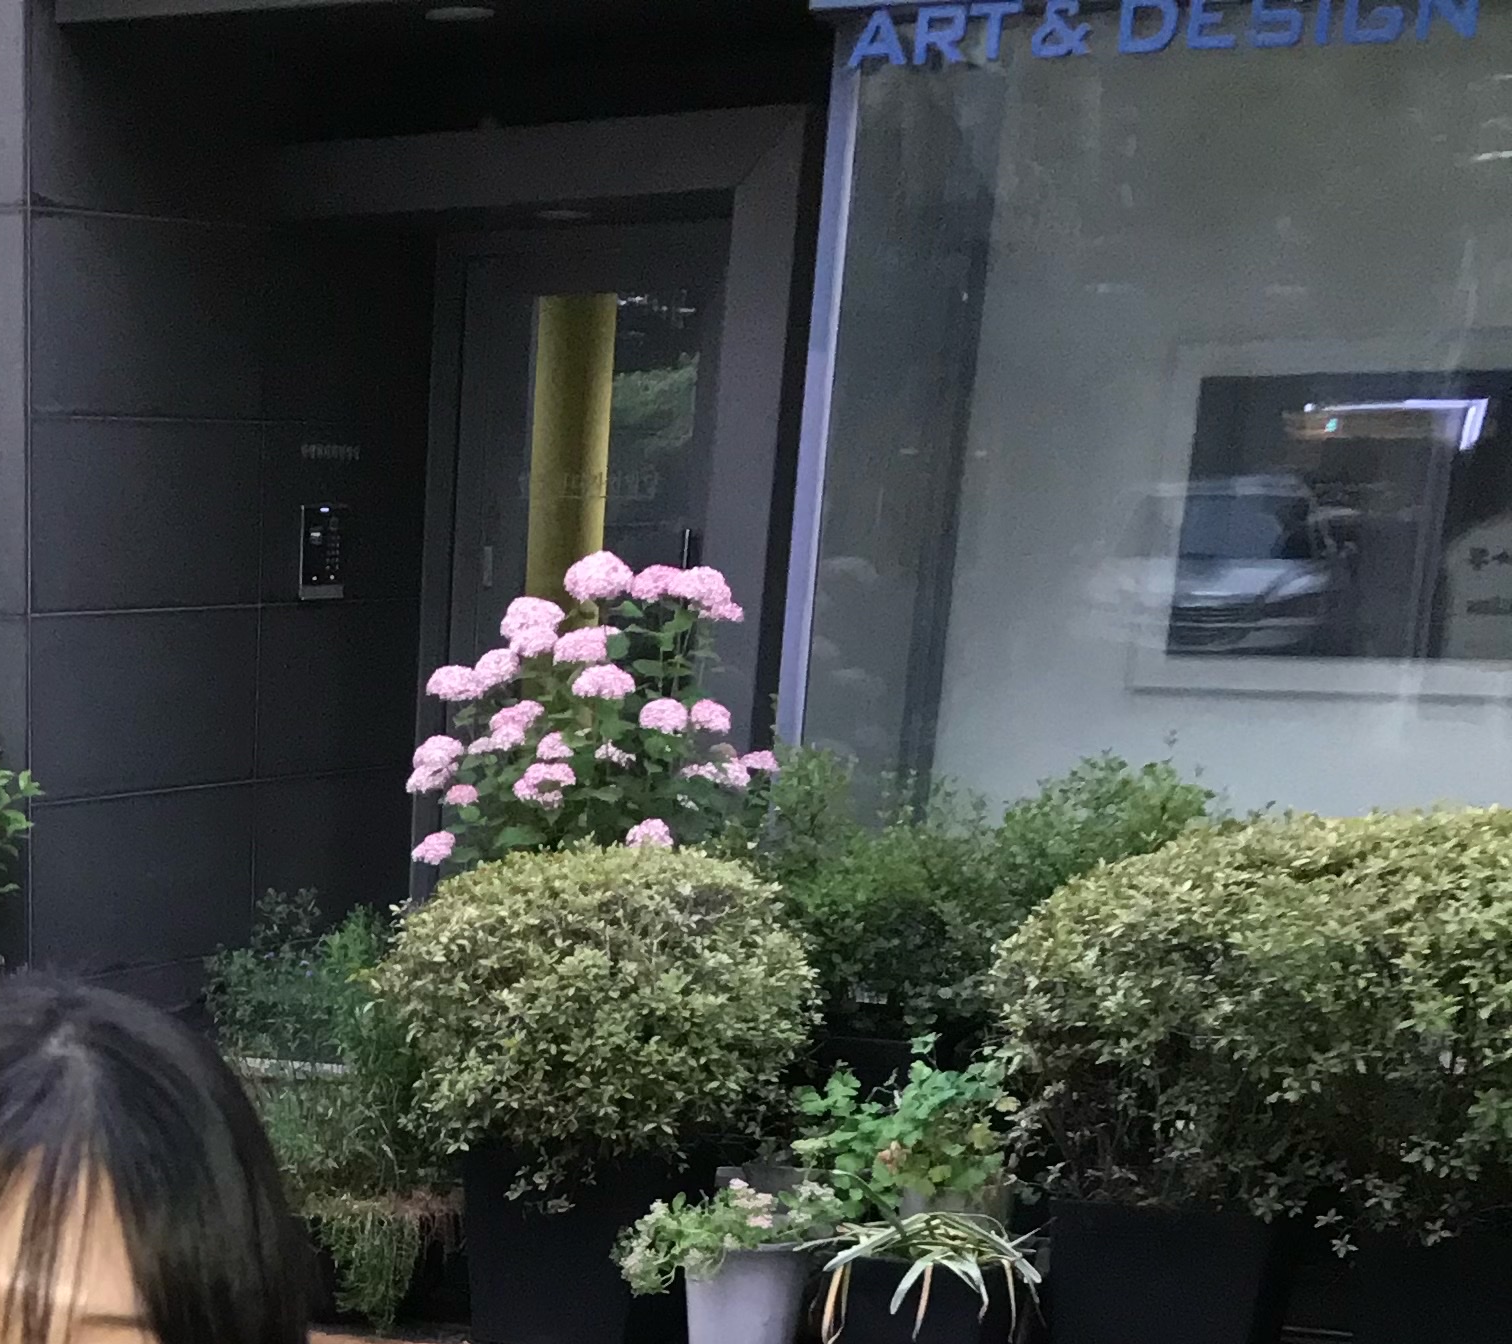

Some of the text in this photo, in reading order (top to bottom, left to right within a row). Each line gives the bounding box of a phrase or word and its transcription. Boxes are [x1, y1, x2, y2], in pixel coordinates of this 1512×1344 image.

[848, 0, 1481, 67] ART & DESIGN
